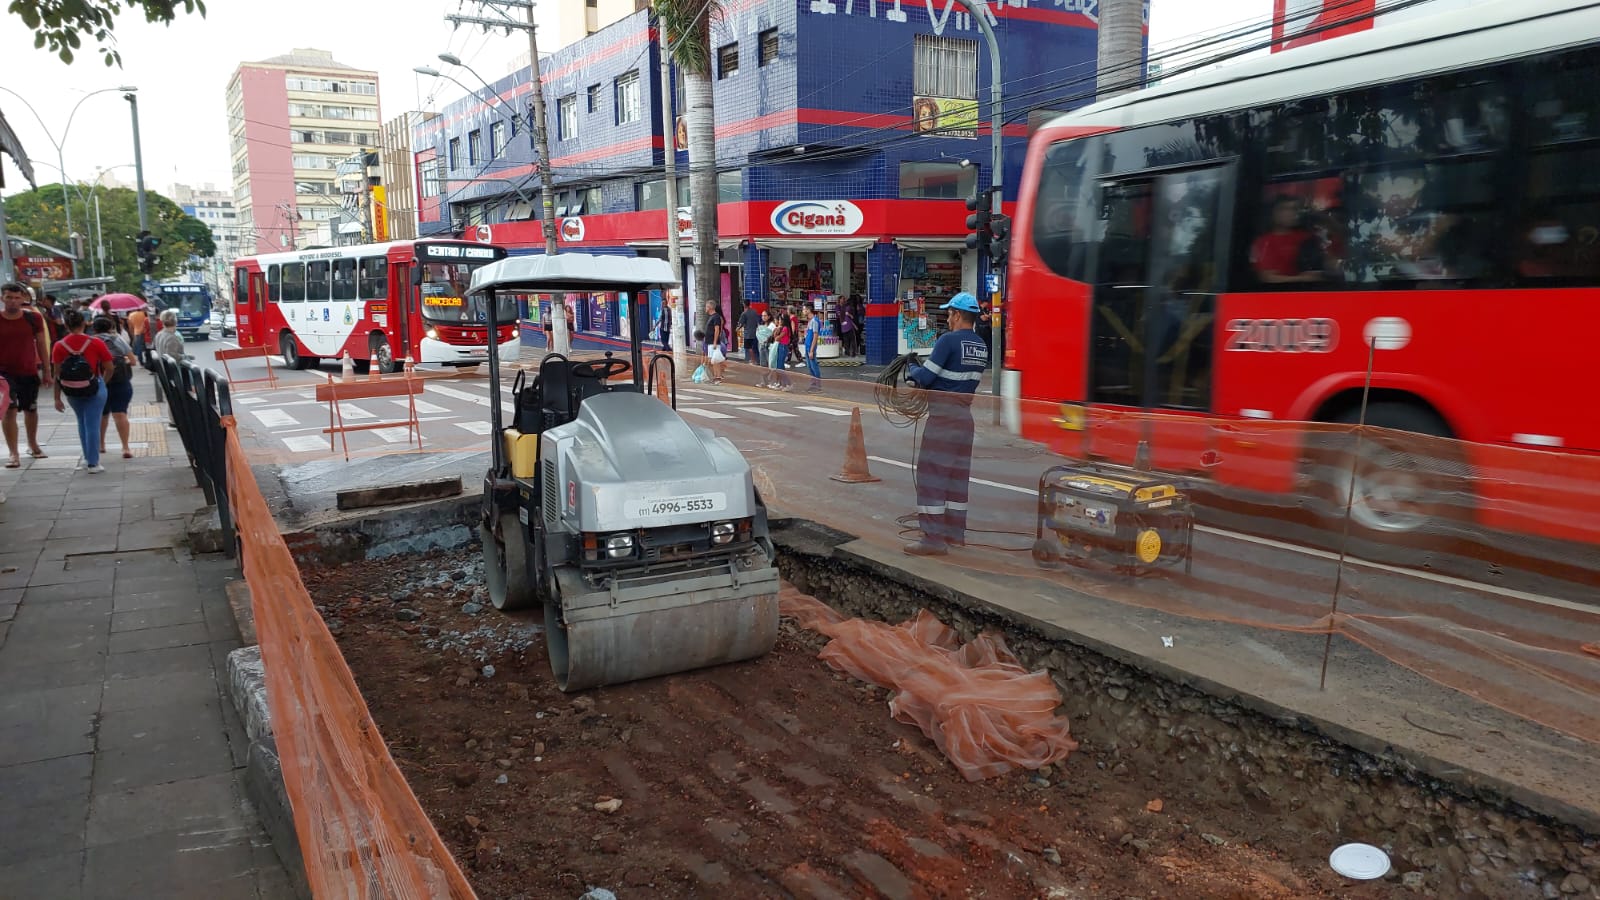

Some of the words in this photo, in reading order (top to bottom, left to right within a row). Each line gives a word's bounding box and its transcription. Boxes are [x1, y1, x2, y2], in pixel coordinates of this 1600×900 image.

[788, 211, 846, 229] Cigana
[638, 508, 650, 517] (11)
[652, 499, 714, 514] 4996-5533
